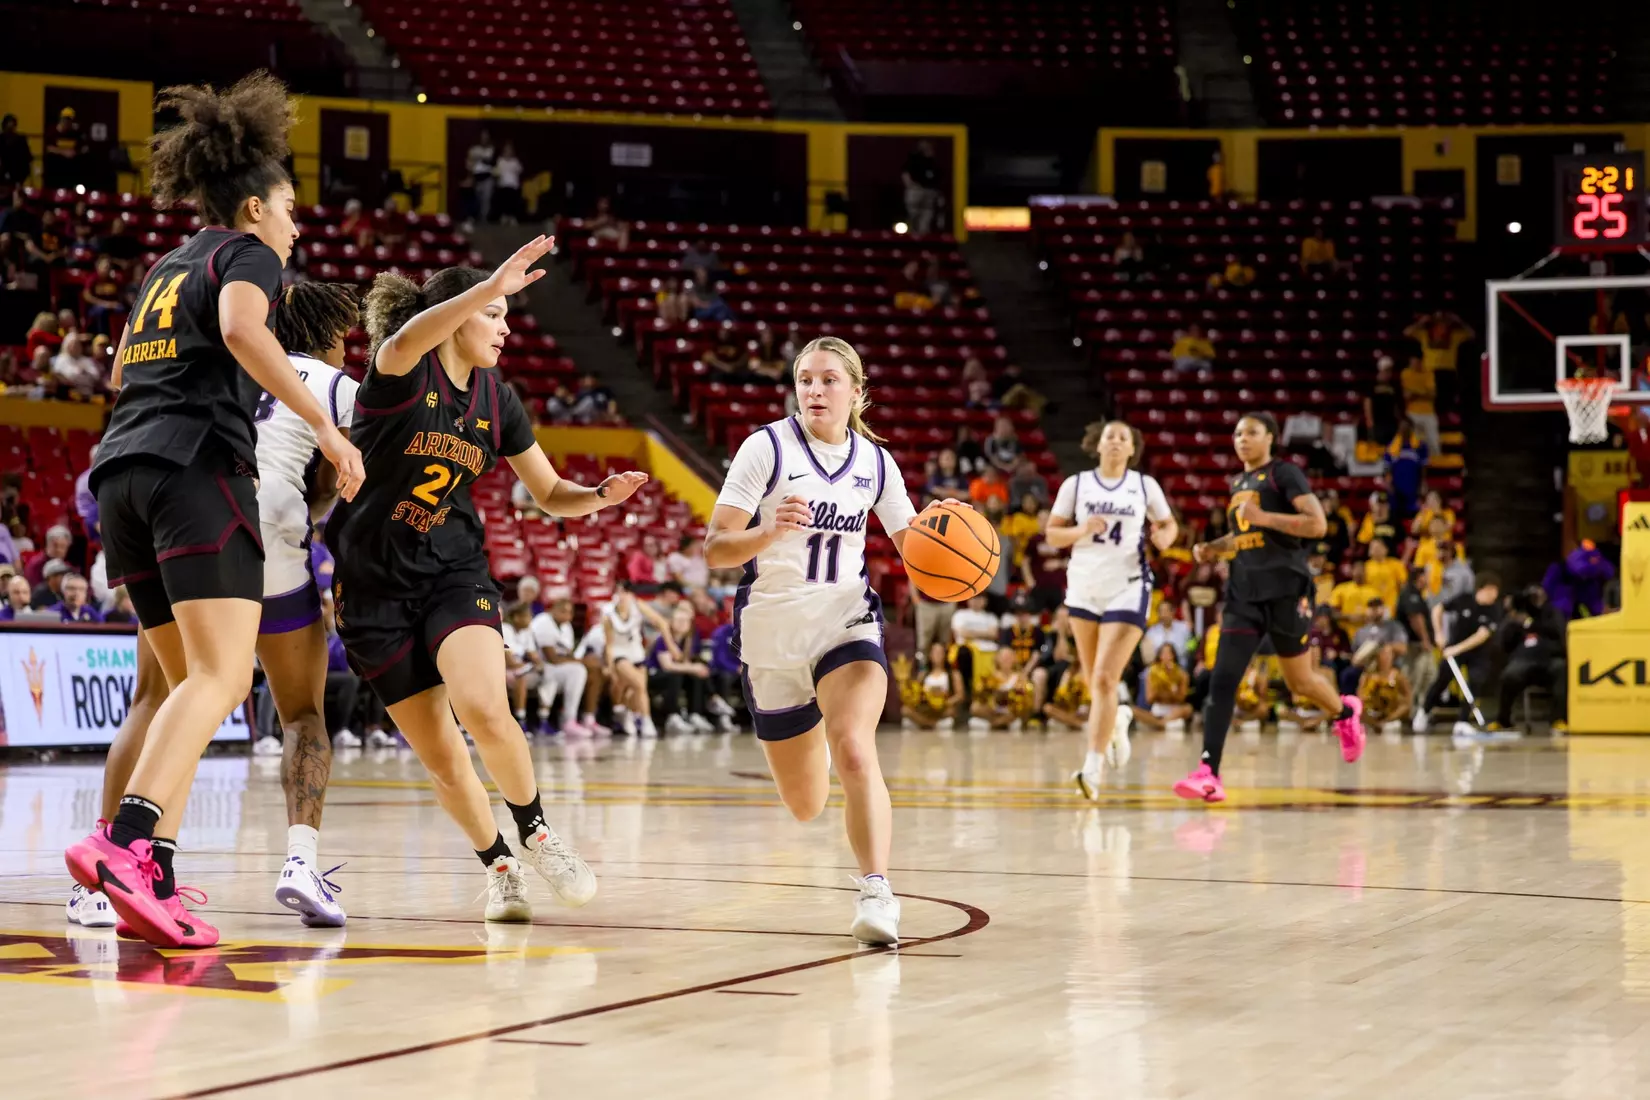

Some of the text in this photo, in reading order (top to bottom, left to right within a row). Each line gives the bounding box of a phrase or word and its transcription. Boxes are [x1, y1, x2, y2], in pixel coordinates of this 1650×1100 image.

[1581, 166, 1634, 194] 2:21
[1573, 193, 1628, 239] 25
[132, 271, 189, 335] 14
[404, 431, 487, 477] ARIZON
[782, 496, 867, 533] ildcat
[805, 531, 843, 584] 11
[1578, 657, 1650, 687] KI
